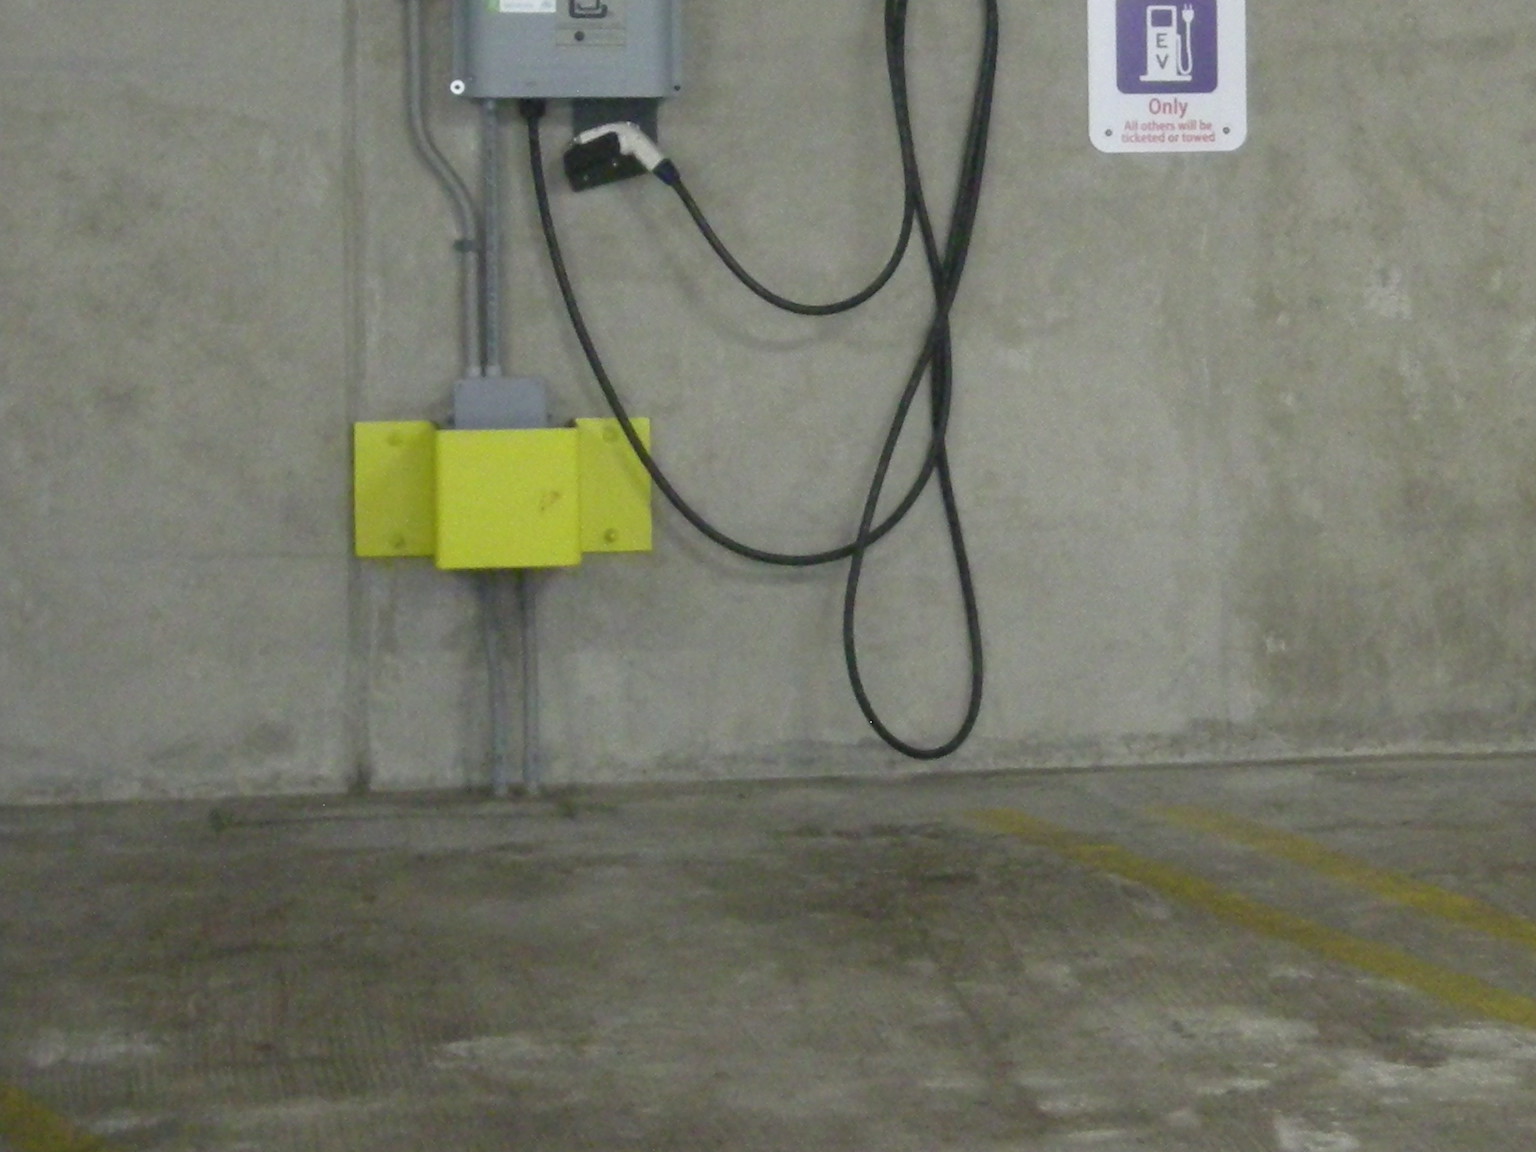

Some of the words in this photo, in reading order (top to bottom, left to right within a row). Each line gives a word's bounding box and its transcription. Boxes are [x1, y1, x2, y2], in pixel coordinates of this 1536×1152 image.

[1148, 97, 1188, 119] Only
[1124, 120, 1138, 130] All
[1140, 120, 1176, 131] others
[1178, 120, 1197, 130] will
[1199, 119, 1212, 130] be
[1121, 133, 1165, 143] ticketed
[1167, 134, 1180, 143] or
[1182, 132, 1216, 143] towed
